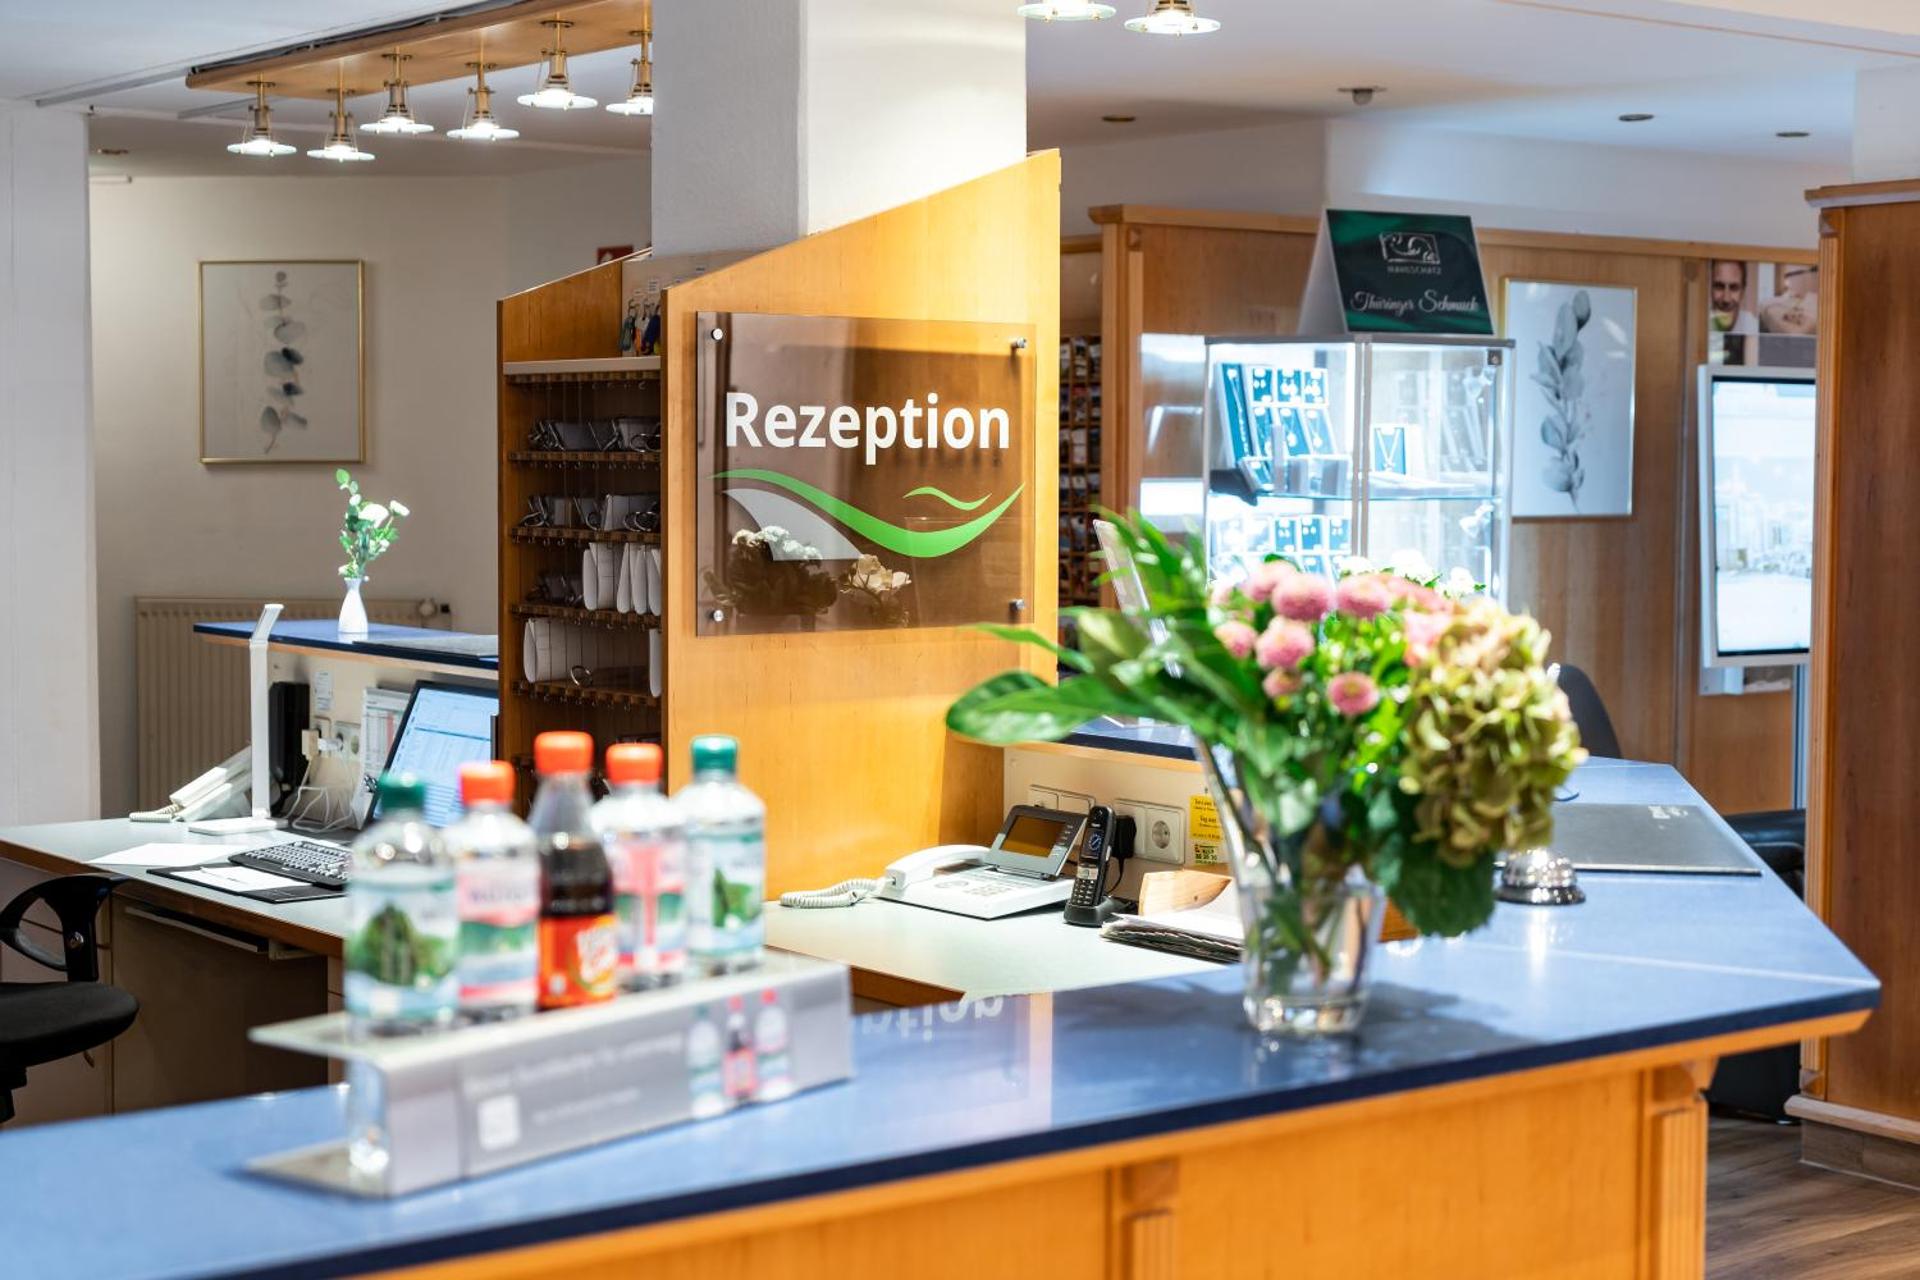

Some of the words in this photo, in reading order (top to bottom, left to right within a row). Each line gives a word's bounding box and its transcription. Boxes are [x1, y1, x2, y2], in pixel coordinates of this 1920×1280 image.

[1350, 290, 1415, 316] Thüringer
[1419, 288, 1480, 313] Schmuck
[726, 392, 1010, 466] Rezeption
